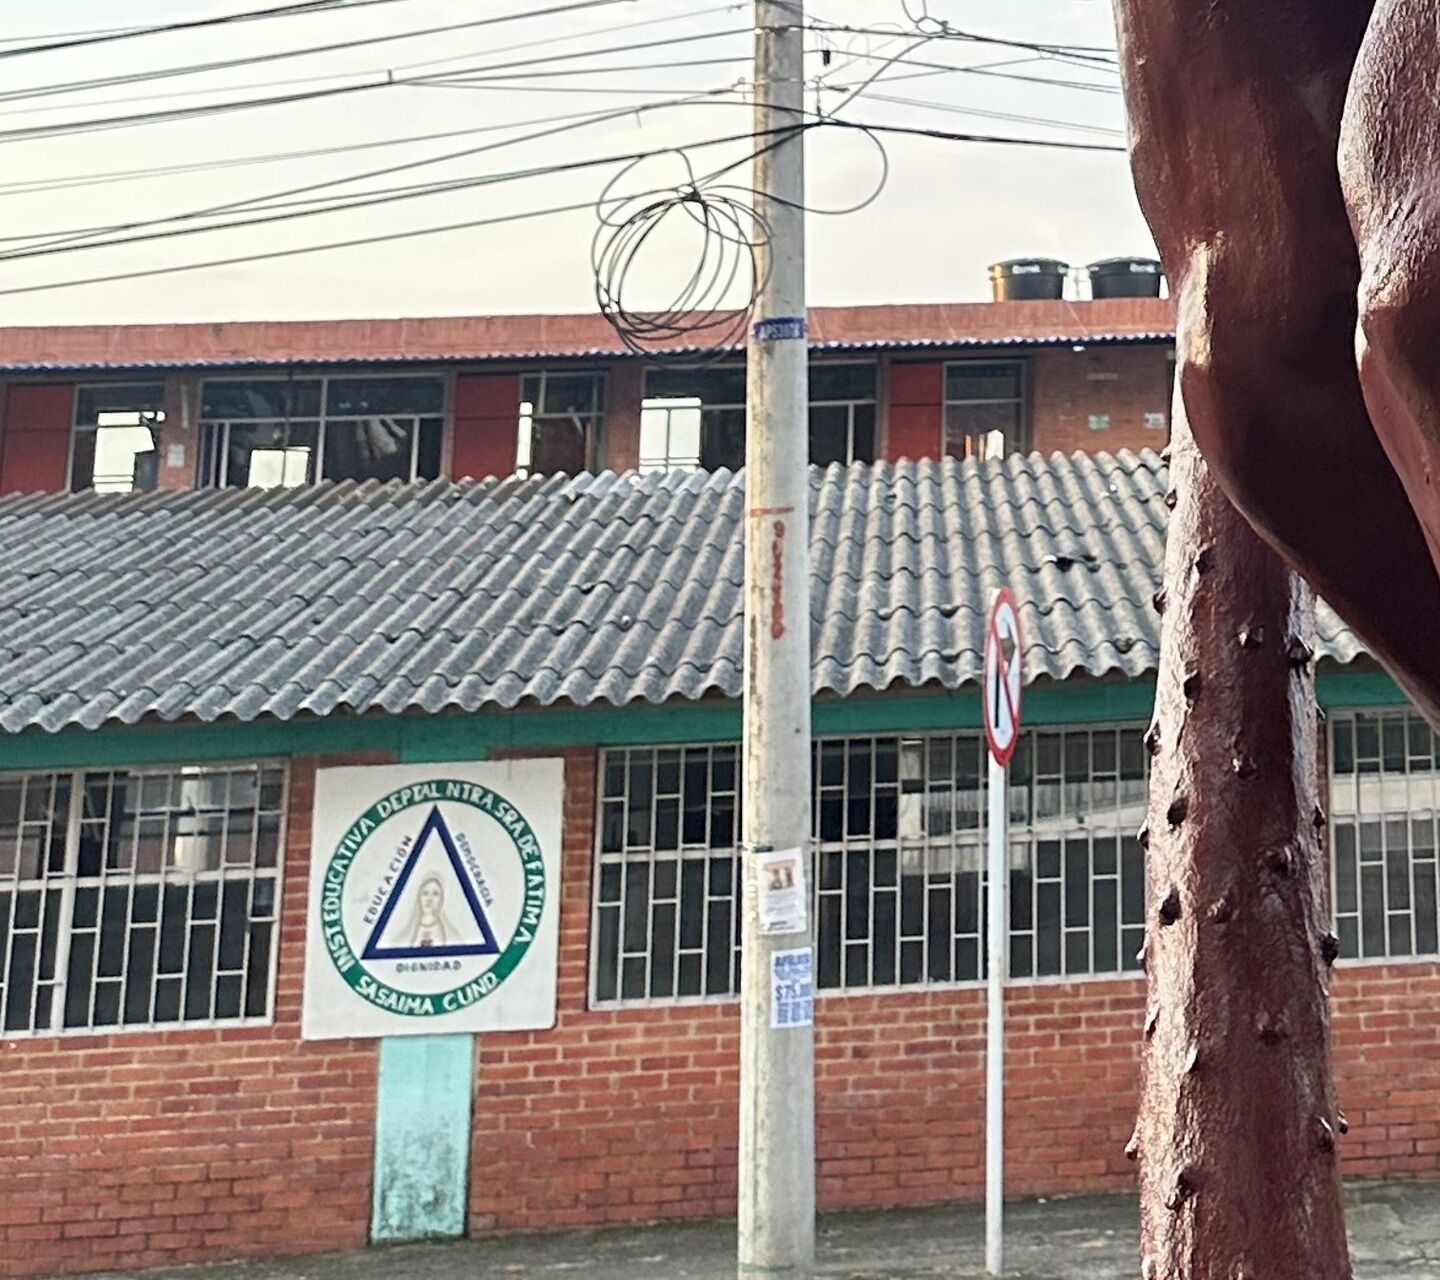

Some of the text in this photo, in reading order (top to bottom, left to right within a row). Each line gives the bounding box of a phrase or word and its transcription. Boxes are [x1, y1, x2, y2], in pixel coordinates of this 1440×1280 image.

[446, 781, 495, 810] NTRA
[494, 802, 525, 838] SRA
[517, 834, 540, 861] DE
[323, 817, 376, 922] EDUCATIVA
[514, 860, 545, 943] FATIMA
[325, 924, 356, 973] INST
[395, 960, 463, 973] DIGNIDAD
[354, 975, 434, 1015] SASAIMA
